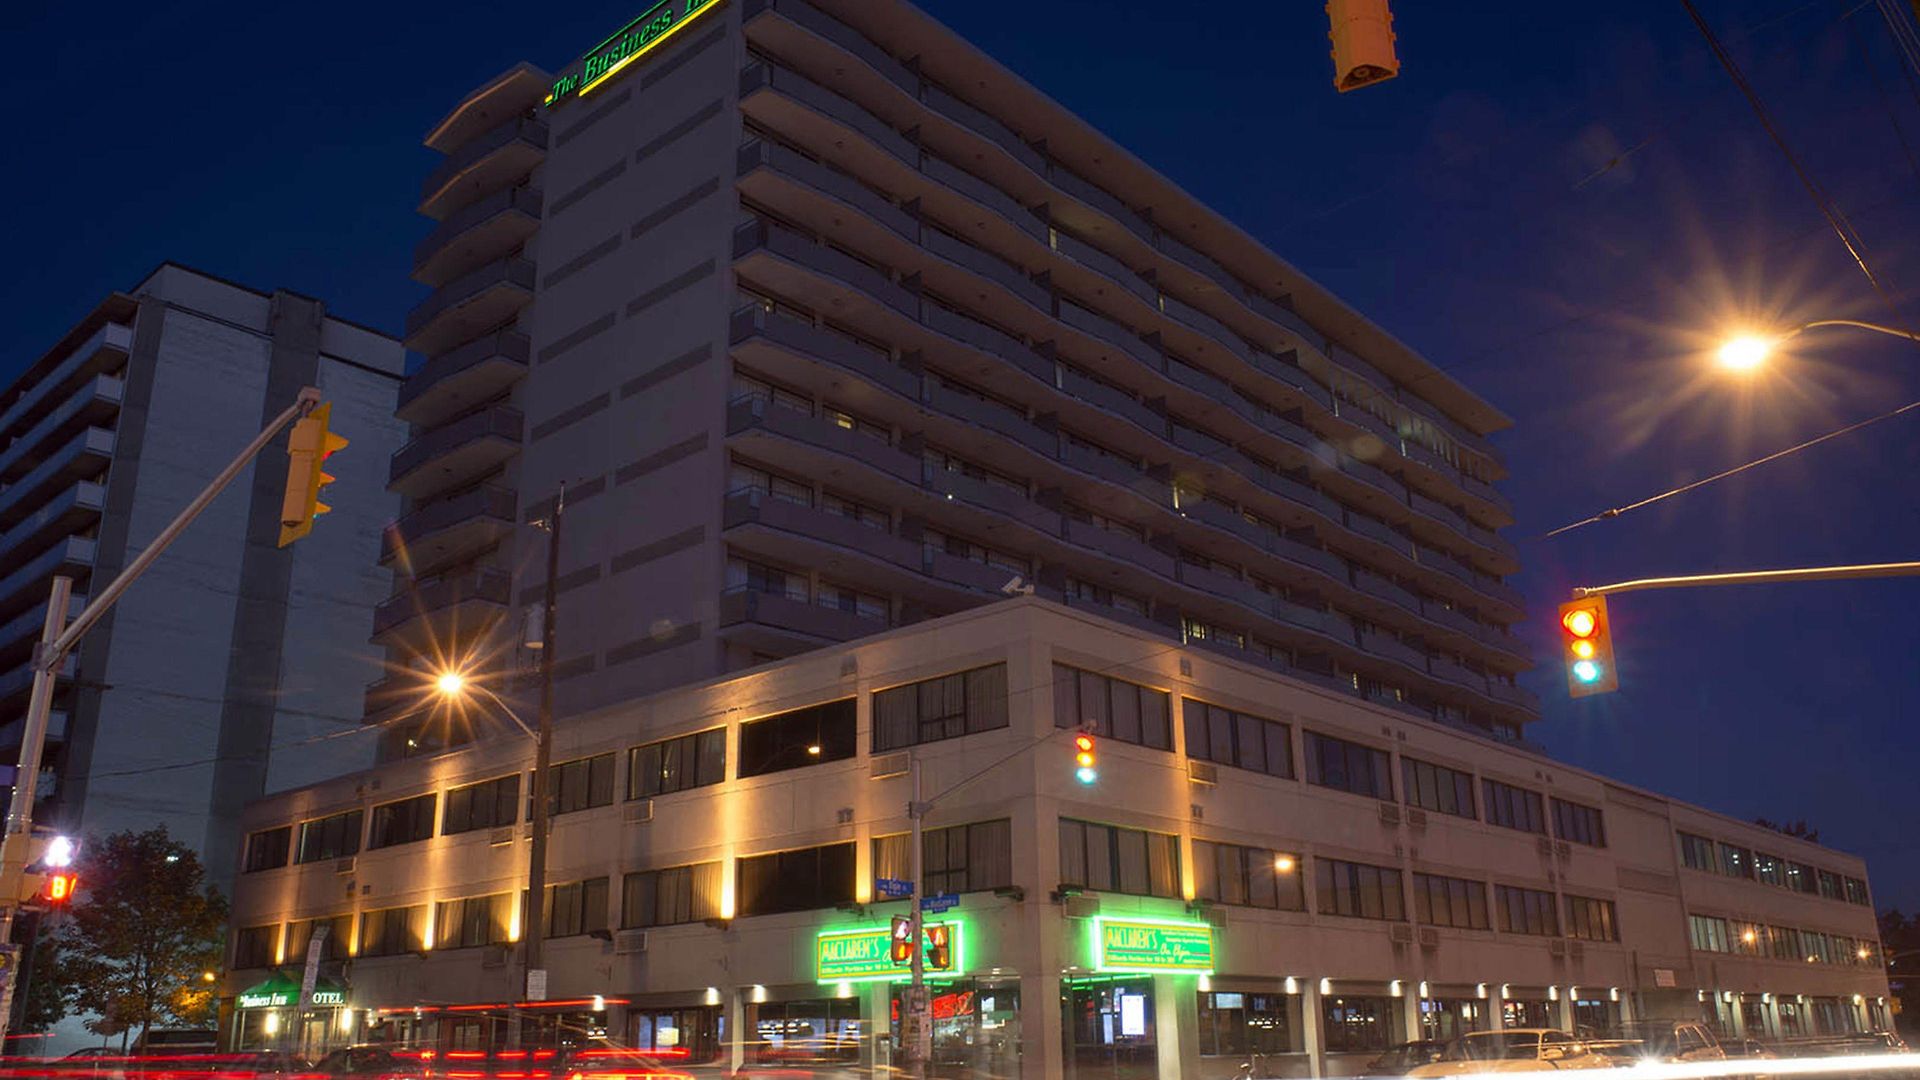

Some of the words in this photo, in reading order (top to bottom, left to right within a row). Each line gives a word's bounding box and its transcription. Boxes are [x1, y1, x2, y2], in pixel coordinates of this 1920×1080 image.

[553, 74, 579, 101] The
[581, 9, 674, 84] Business
[312, 992, 344, 1004] OTEL
